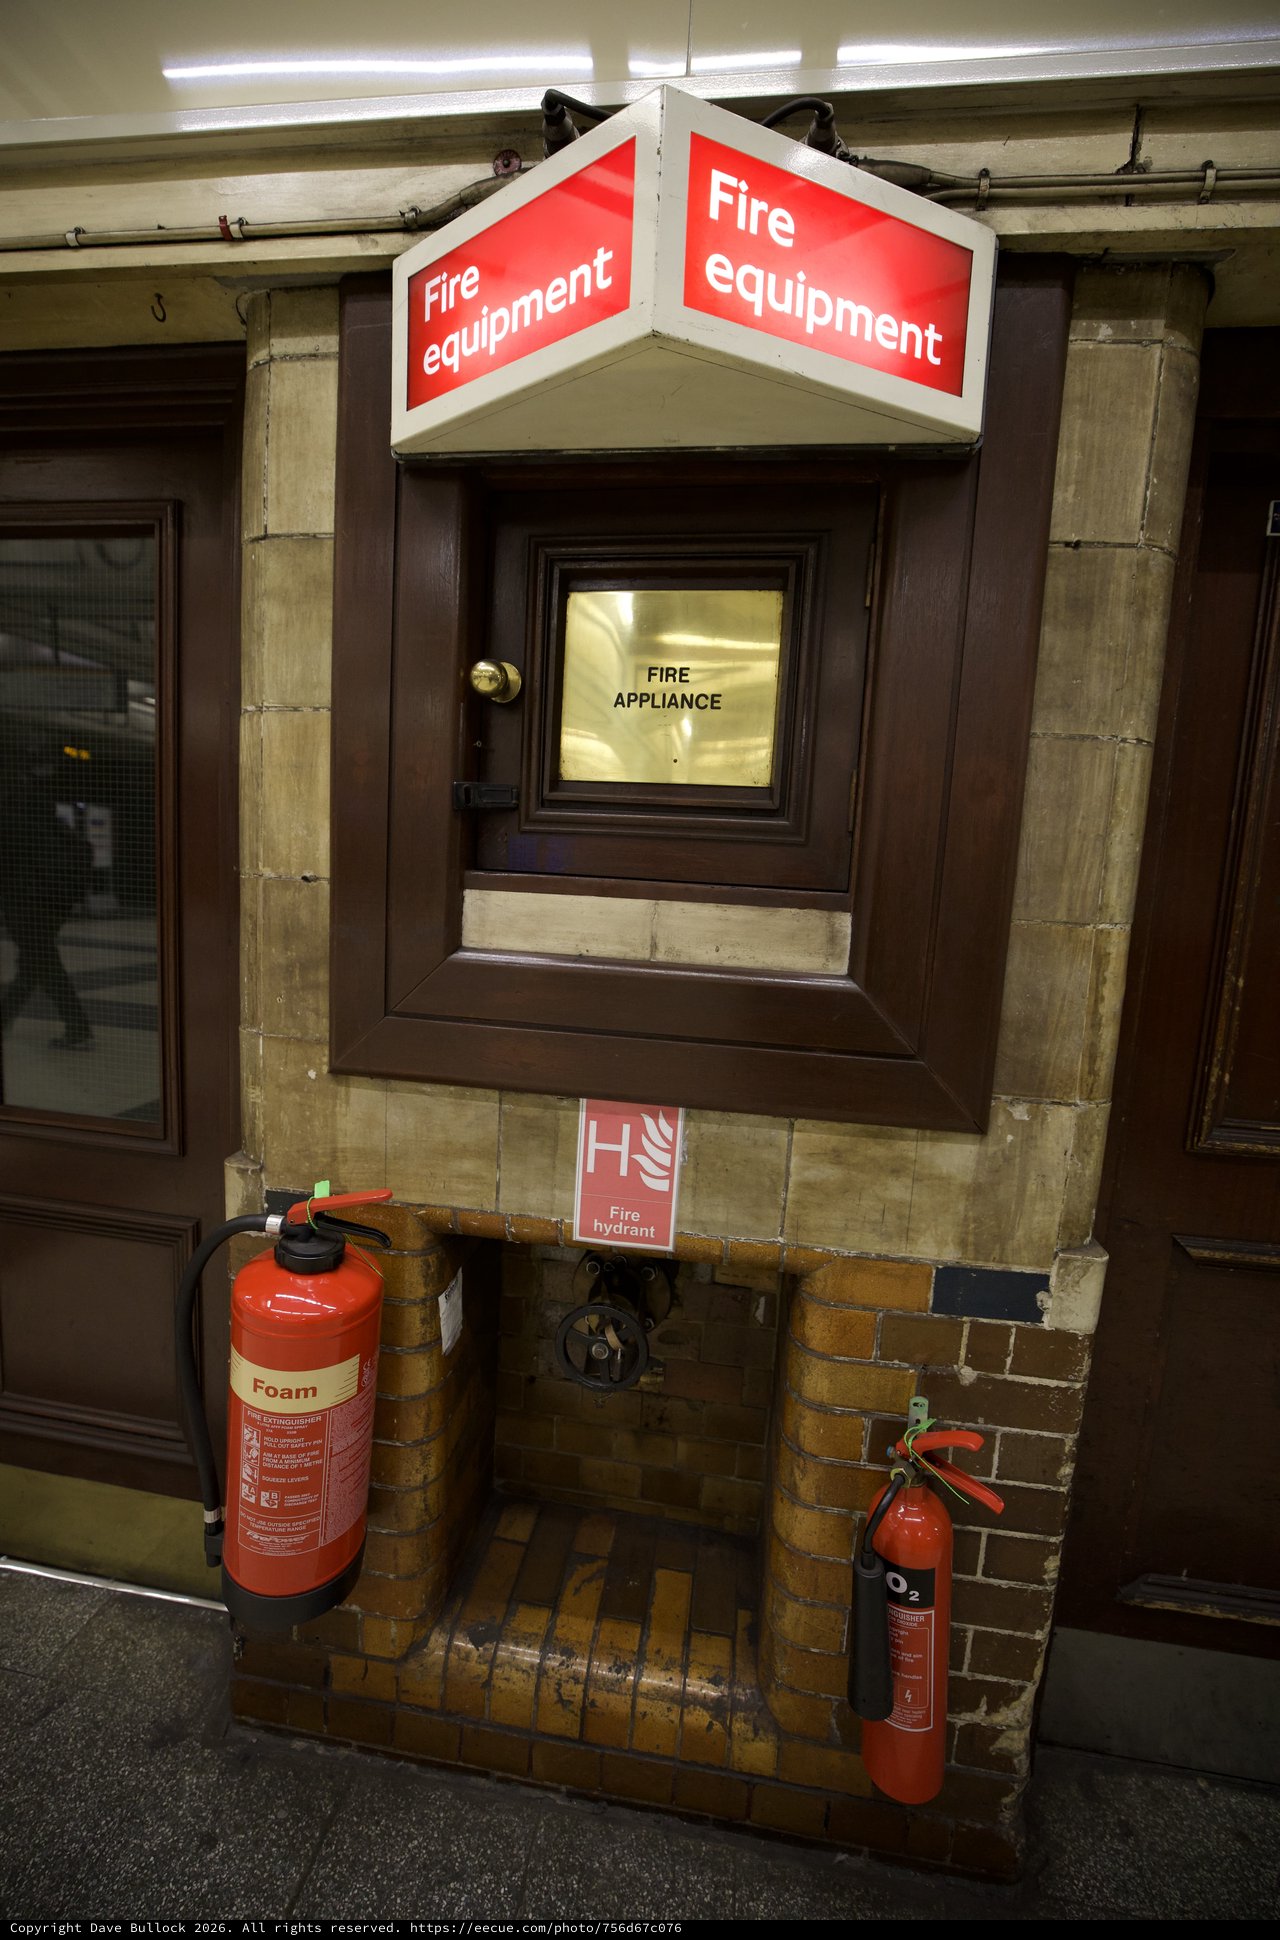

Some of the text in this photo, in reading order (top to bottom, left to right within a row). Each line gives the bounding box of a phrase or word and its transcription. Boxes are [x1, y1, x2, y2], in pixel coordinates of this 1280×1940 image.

[709, 168, 795, 248] Fire
[425, 265, 480, 323] Fire
[423, 247, 613, 375] equipment
[705, 253, 942, 365] equipment
[647, 666, 691, 683] FIRE
[613, 692, 723, 710] APPLIANCE
[586, 1120, 631, 1177] H
[609, 1206, 641, 1222] Fire
[593, 1219, 655, 1239] hydrant
[253, 1377, 318, 1400] Foam
[247, 1410, 322, 1426] FIRE EXTINGUISHER
[290, 1441, 312, 1449] SAFETY
[303, 1459, 323, 1468] METRE
[271, 1492, 278, 1500] B
[249, 1522, 286, 1532] TEMPERATURE
[291, 1516, 320, 1526] SPECIFIED
[886, 1571, 920, 1601] O2
[888, 1608, 925, 1622] NGUISHER
[897, 1618, 918, 1627] DIOXIDE
